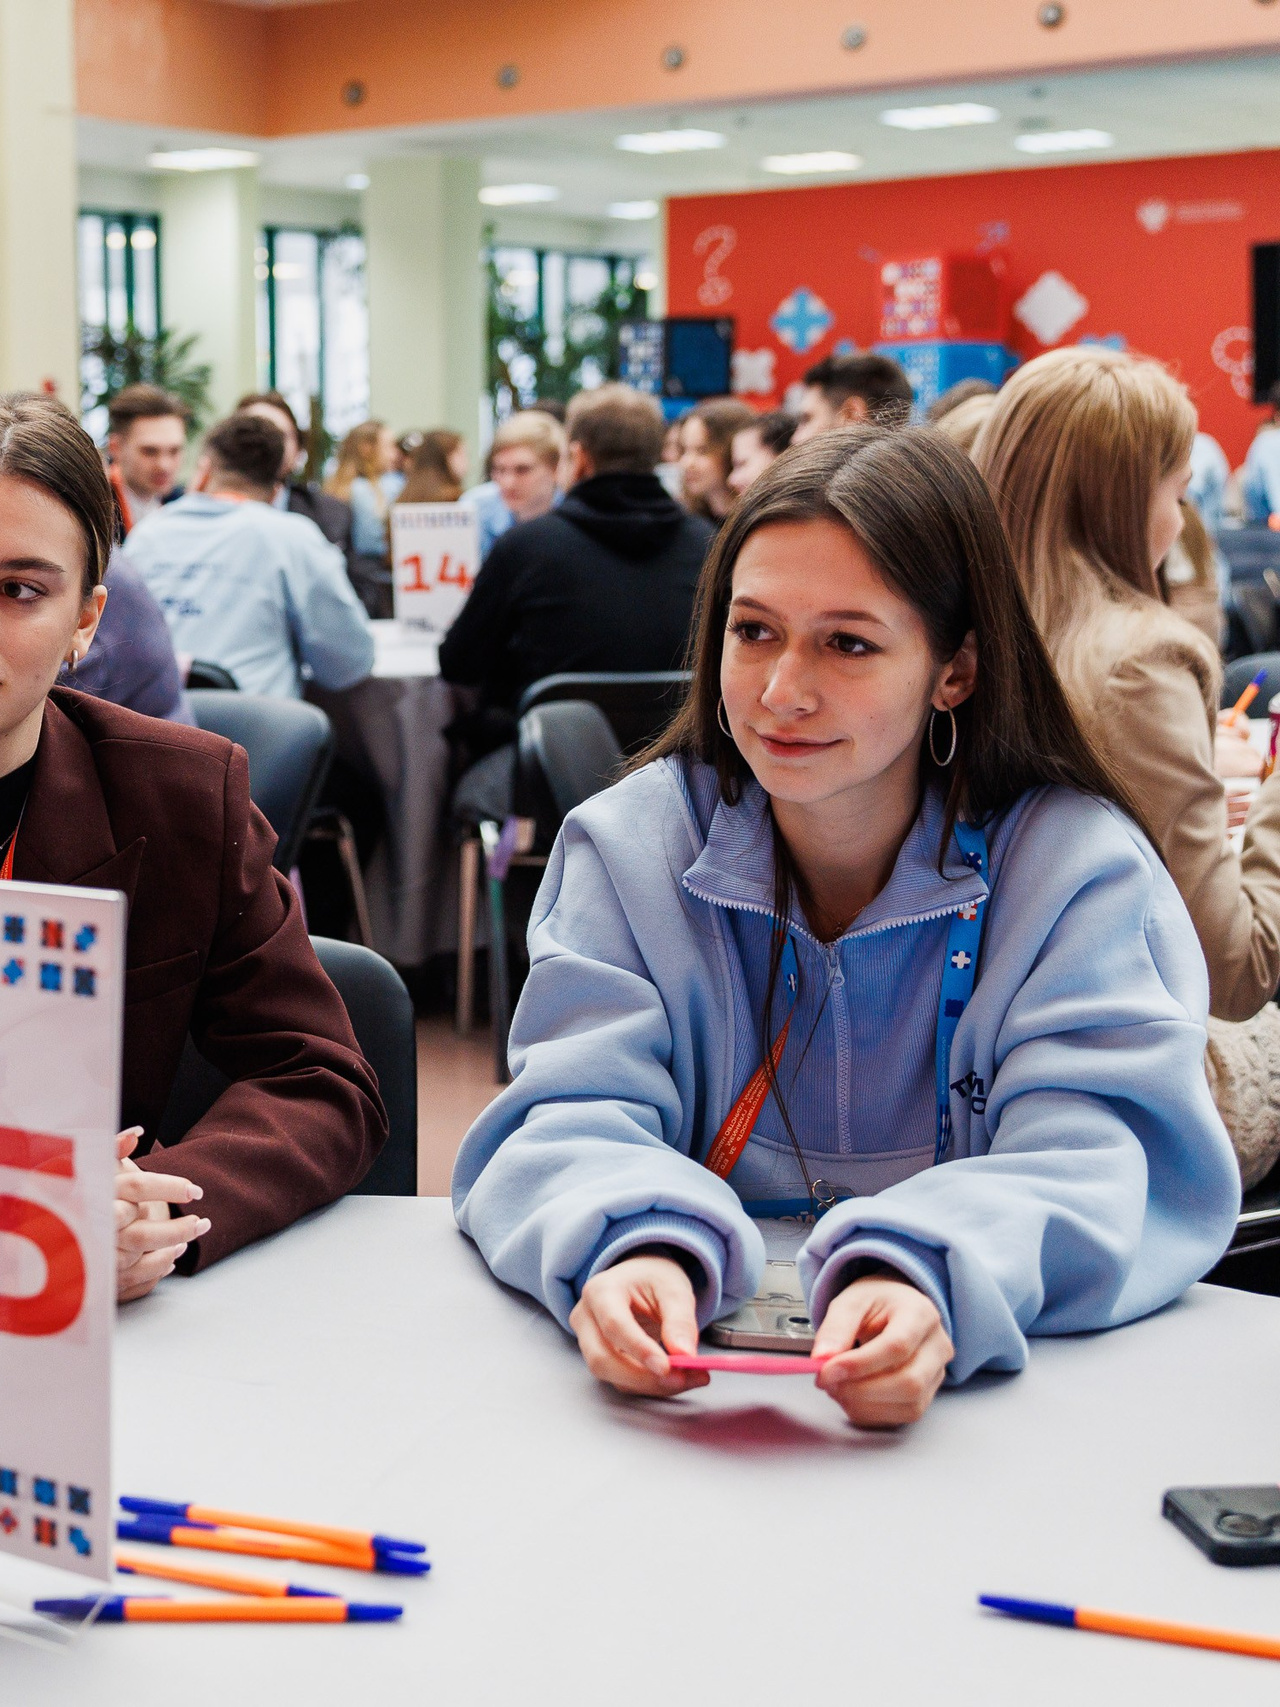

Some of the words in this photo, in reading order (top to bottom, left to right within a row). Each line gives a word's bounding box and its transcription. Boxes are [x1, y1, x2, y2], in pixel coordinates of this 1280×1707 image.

[402, 553, 475, 592] 14
[724, 1102, 745, 1136] ЕДИНСТВО
[736, 1082, 767, 1141] ОТВЕТСТВЕННОСТЬ
[720, 1158, 729, 1170] ЕГО
[728, 1145, 737, 1155] ЗА
